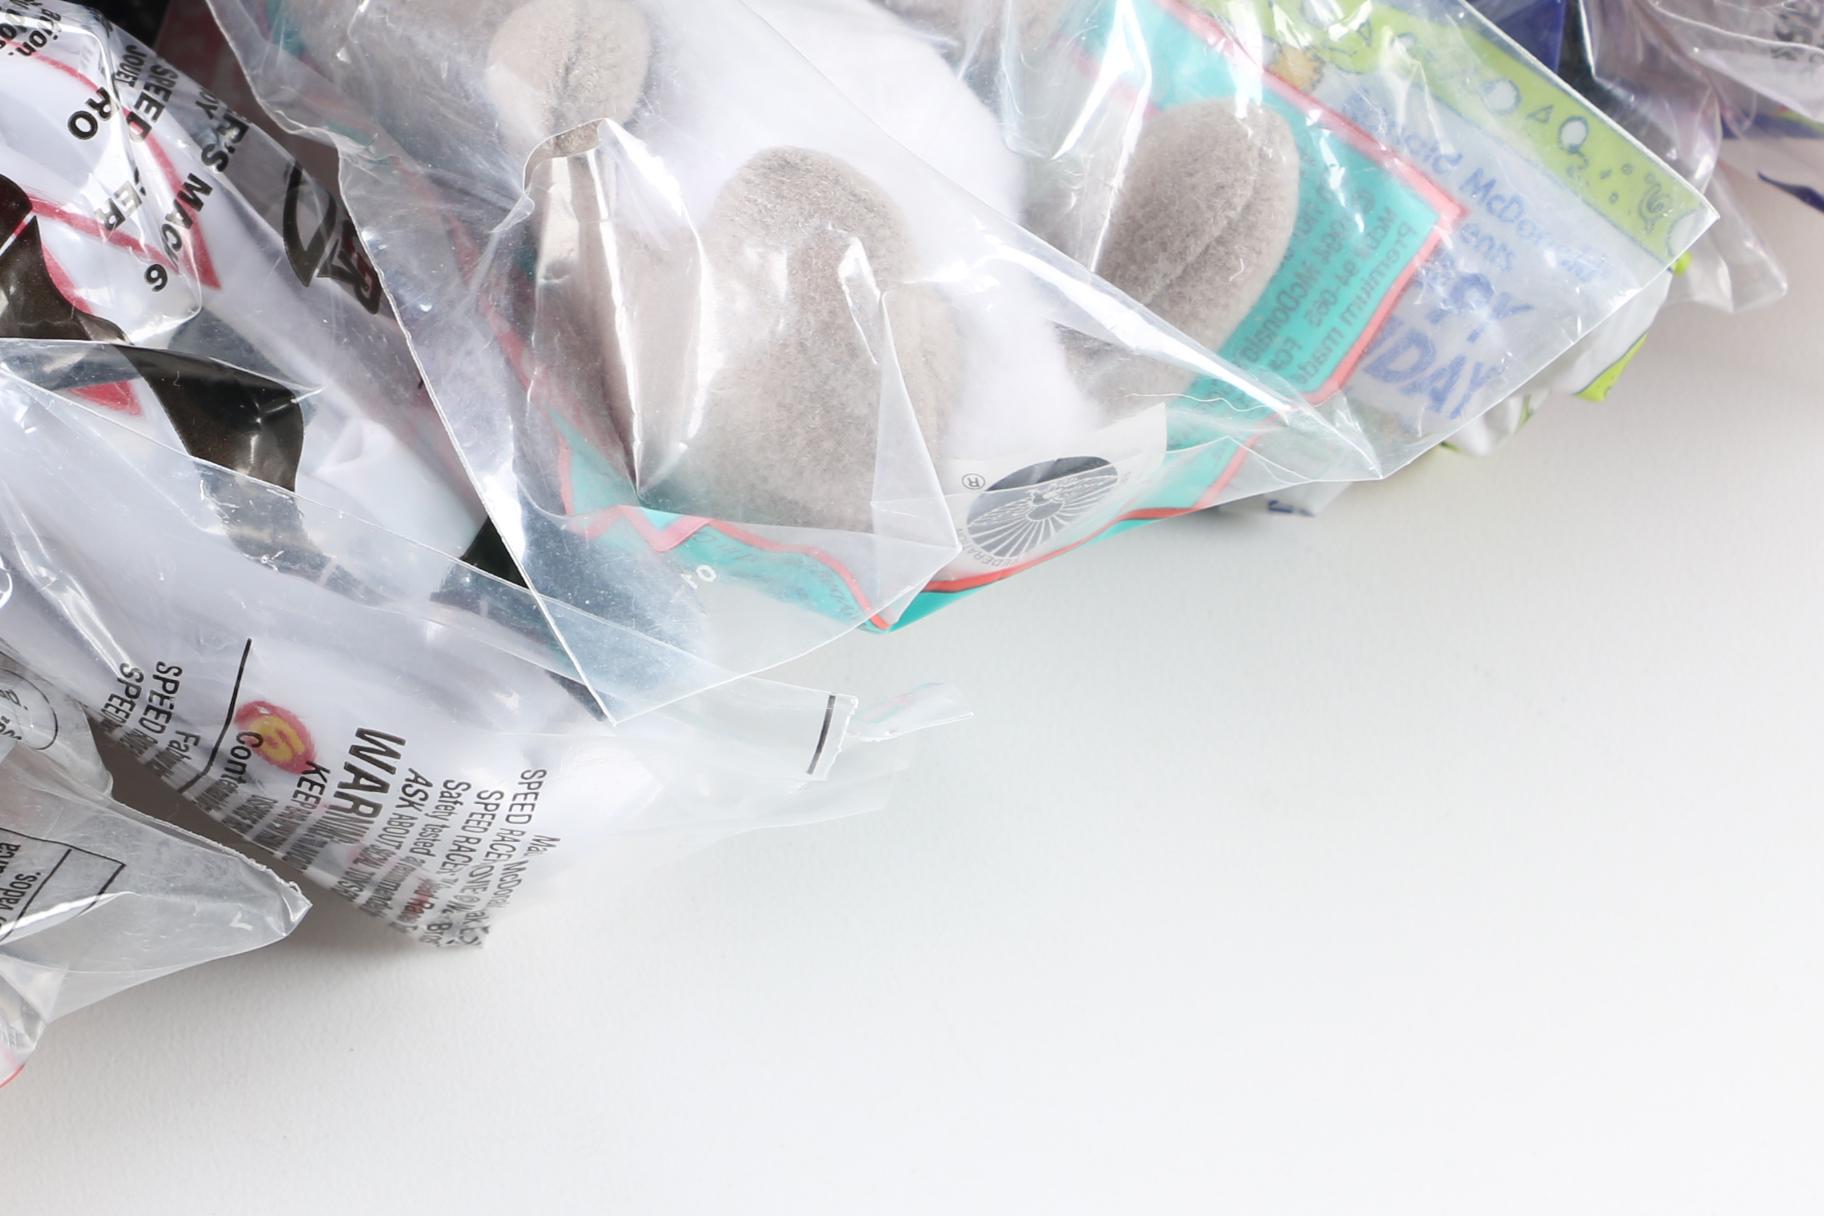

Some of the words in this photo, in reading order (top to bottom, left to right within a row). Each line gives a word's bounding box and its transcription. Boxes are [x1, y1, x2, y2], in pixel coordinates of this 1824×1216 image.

[100, 661, 145, 725] SPEED
[138, 660, 184, 735] SPEED
[394, 767, 434, 812] ASK
[431, 778, 472, 824] Safety
[461, 788, 505, 835] SPEED
[504, 768, 548, 825] SPEED
[377, 812, 419, 851] ABOUT
